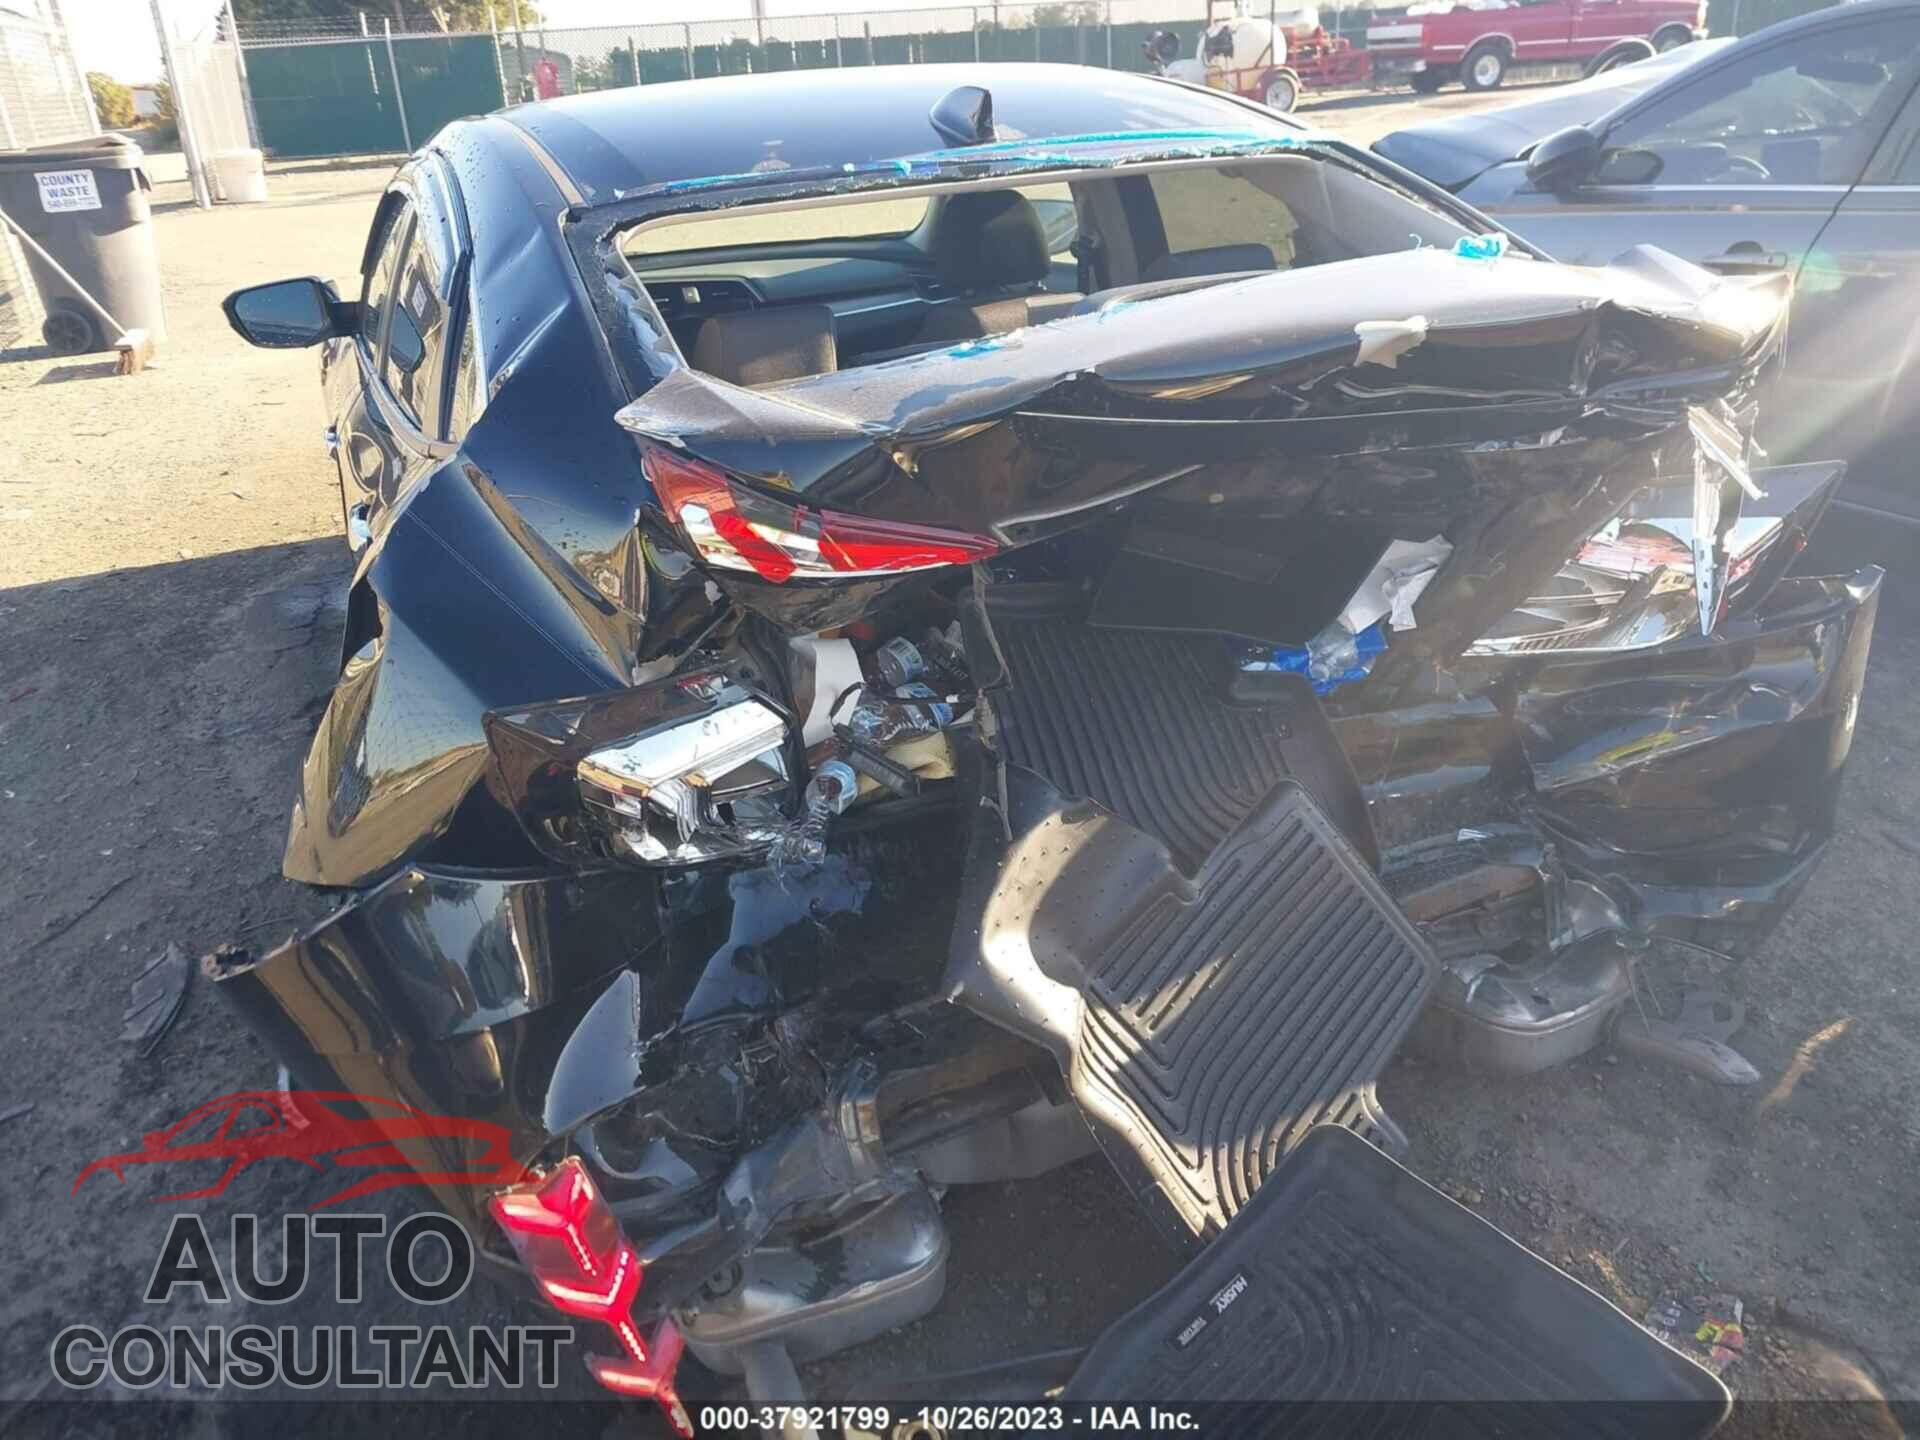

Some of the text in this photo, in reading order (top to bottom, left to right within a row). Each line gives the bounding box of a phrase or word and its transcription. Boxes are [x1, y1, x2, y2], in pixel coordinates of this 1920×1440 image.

[41, 174, 88, 186] COUNTY
[47, 186, 90, 198] WASTE
[1215, 1275, 1248, 1314] HUSKY
